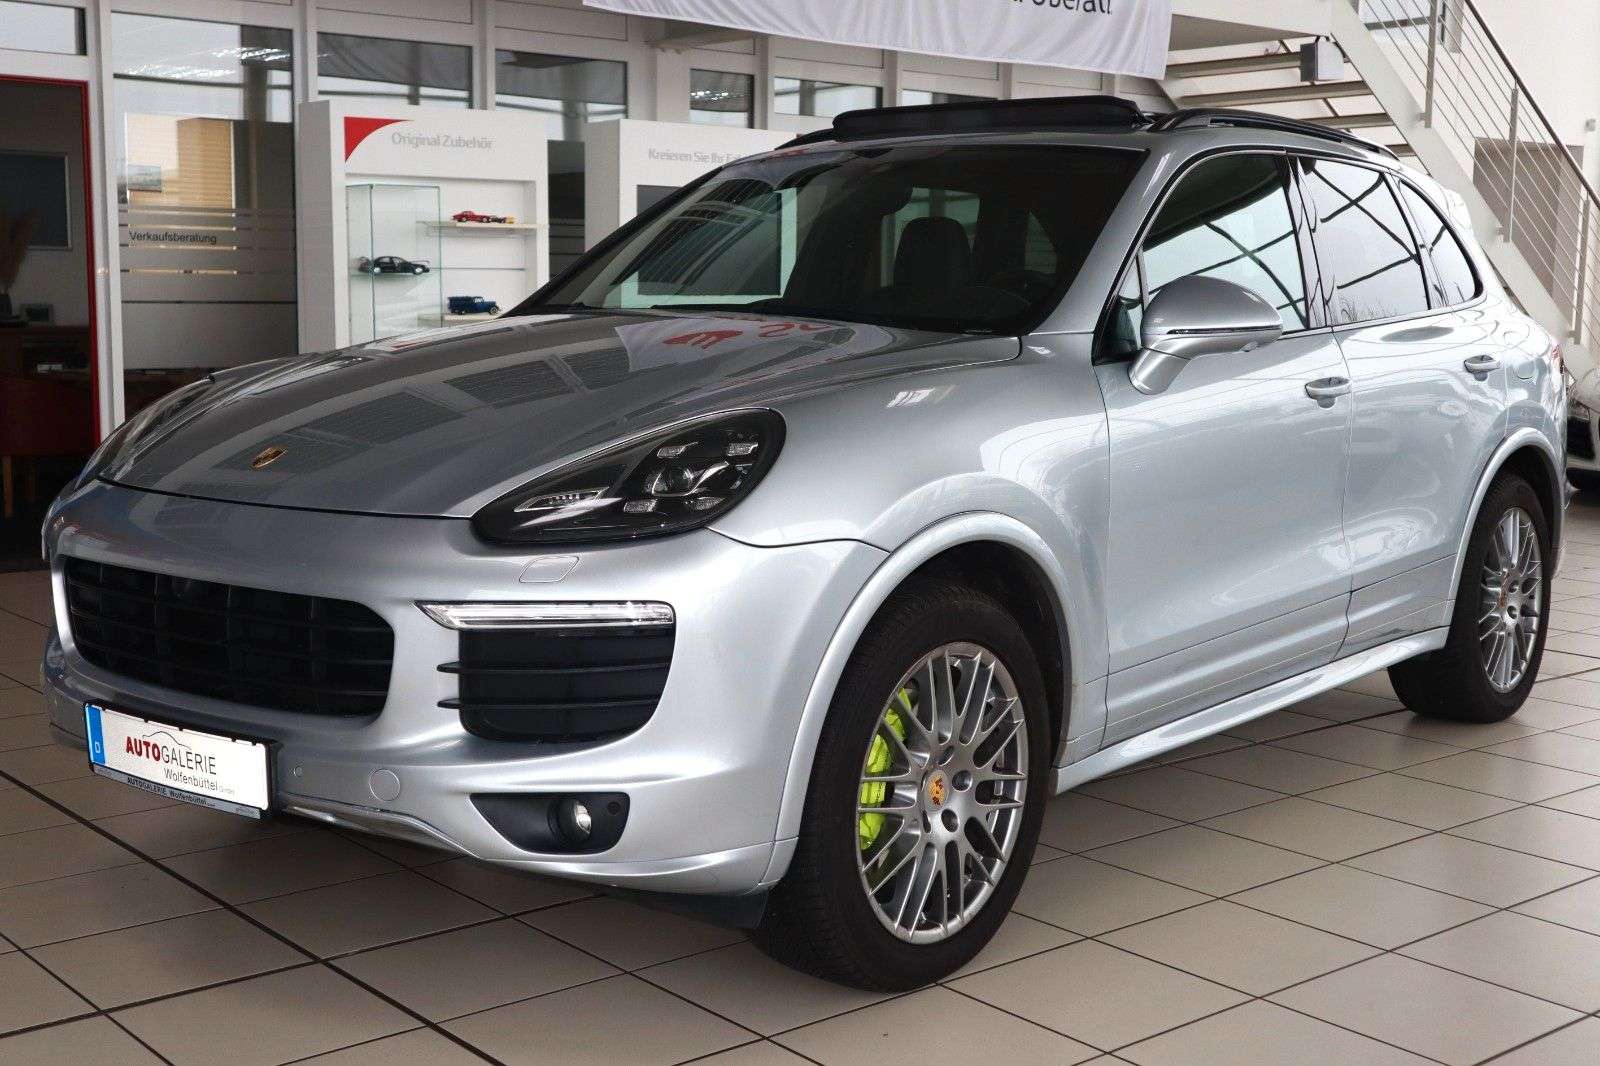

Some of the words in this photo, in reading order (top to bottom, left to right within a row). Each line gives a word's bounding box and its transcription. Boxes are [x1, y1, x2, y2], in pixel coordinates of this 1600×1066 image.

[1032, 0, 1112, 14] erall
[391, 132, 440, 149] Original
[442, 134, 493, 149] Zubehör
[129, 231, 217, 245] Verkaufsberatung
[126, 736, 216, 775] AUTOGALERIE
[127, 776, 168, 797] AUTOGALERIE
[163, 767, 218, 791] Wolfenbüttel
